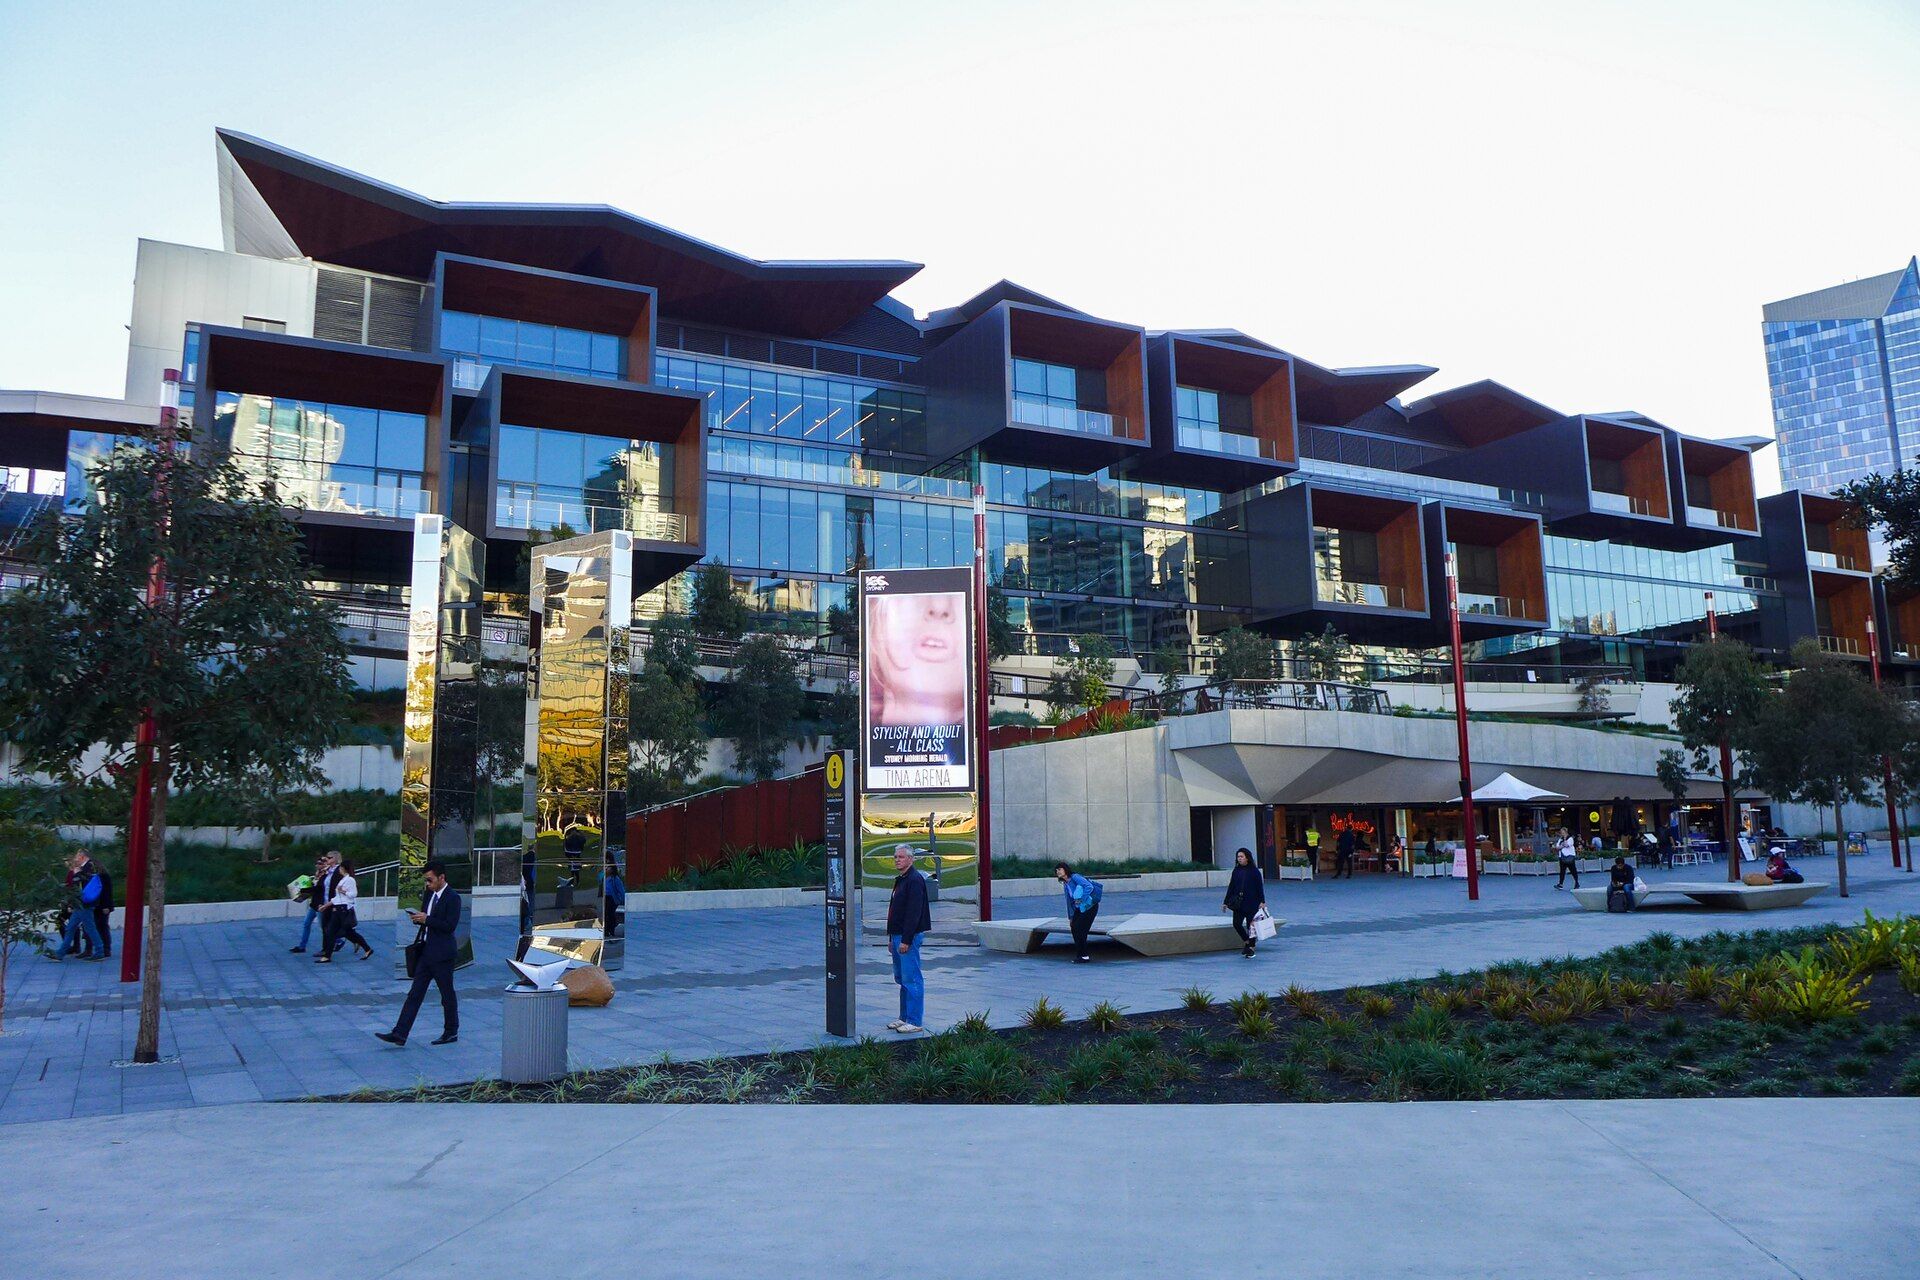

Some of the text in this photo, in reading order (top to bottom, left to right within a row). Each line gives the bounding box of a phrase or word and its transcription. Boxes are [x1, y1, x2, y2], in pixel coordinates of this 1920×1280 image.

[872, 725, 961, 739] STYLISH AND ADULT
[896, 740, 912, 752] ALL
[915, 739, 945, 752] CLASS
[884, 754, 948, 764] SYDNEY MORNING HERALD
[885, 768, 951, 787] TINA ARENA
